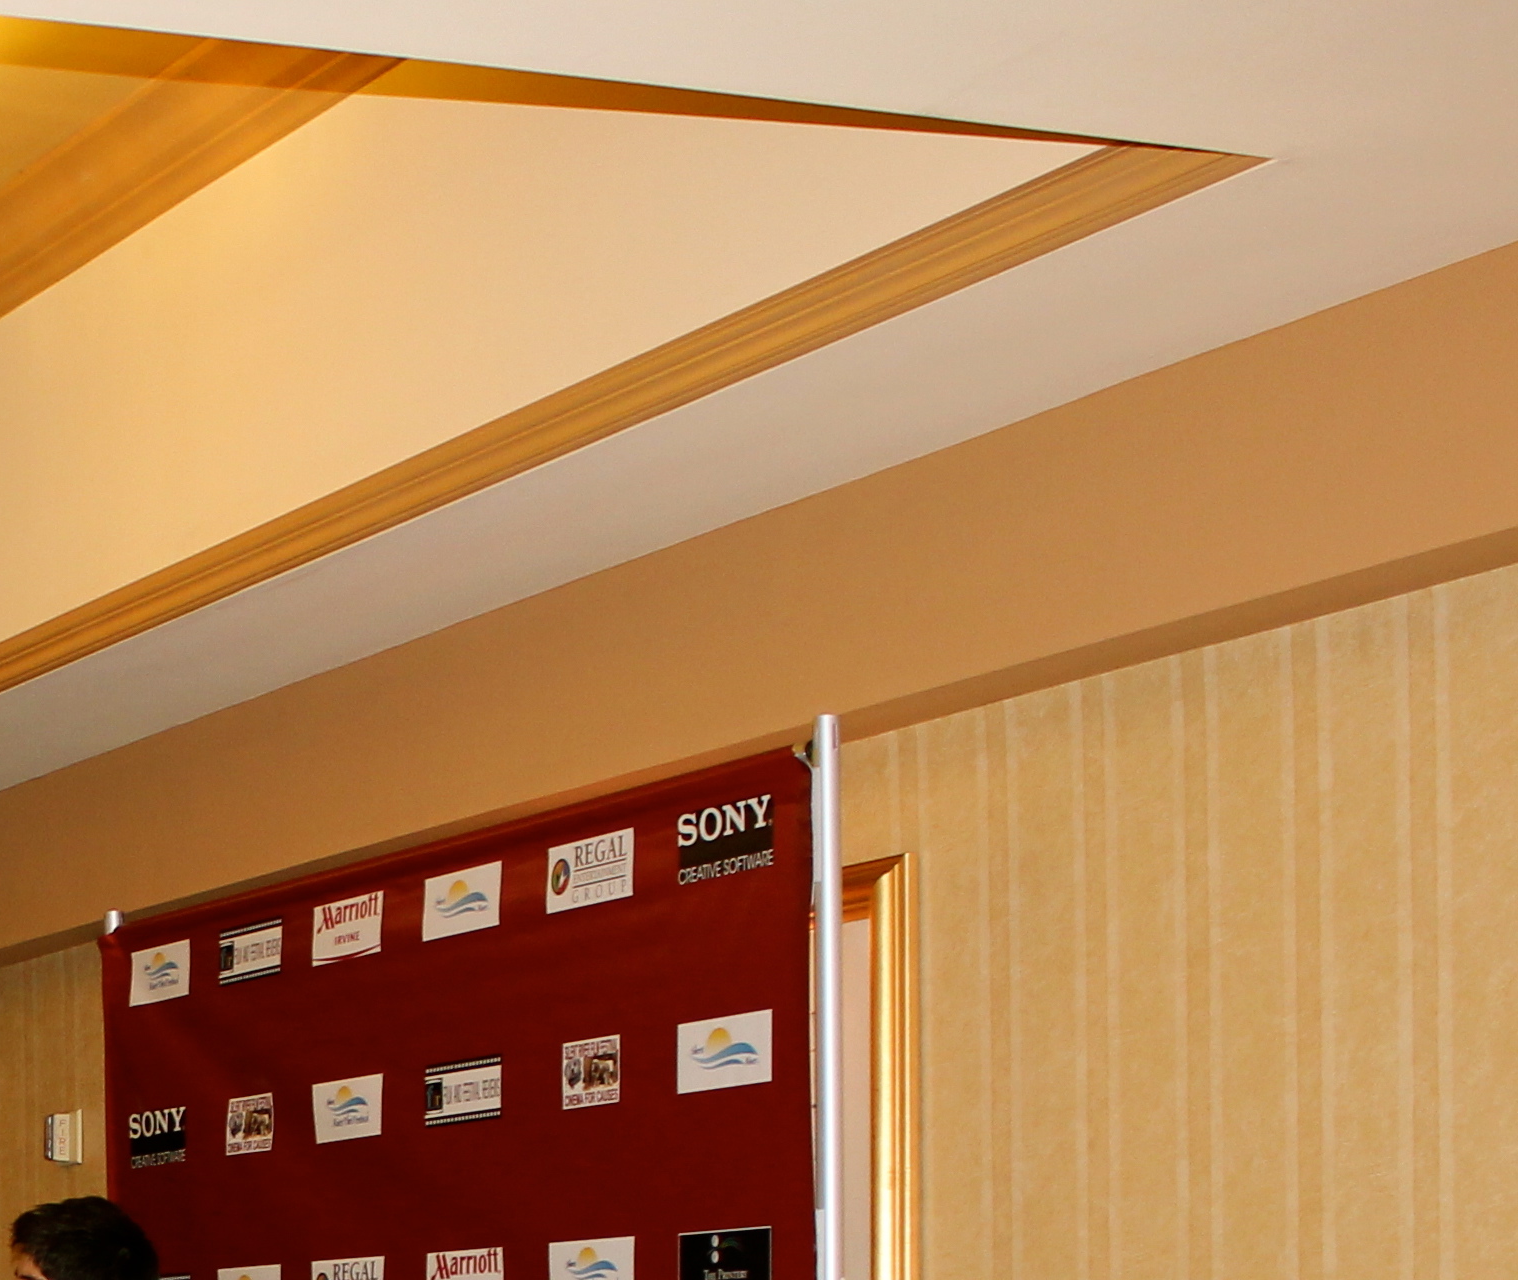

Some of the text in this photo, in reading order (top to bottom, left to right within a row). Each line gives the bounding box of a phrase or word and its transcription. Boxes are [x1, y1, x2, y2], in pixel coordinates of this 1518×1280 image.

[678, 795, 771, 847] SONY
[575, 836, 627, 868] REGAL
[678, 849, 773, 885] CREATIVE SOFTWARE
[572, 881, 627, 904] GROUP
[317, 893, 379, 934] Marriott
[335, 931, 360, 945] IRVINE
[59, 1118, 67, 1156] FIRE
[129, 1107, 186, 1139] SONY
